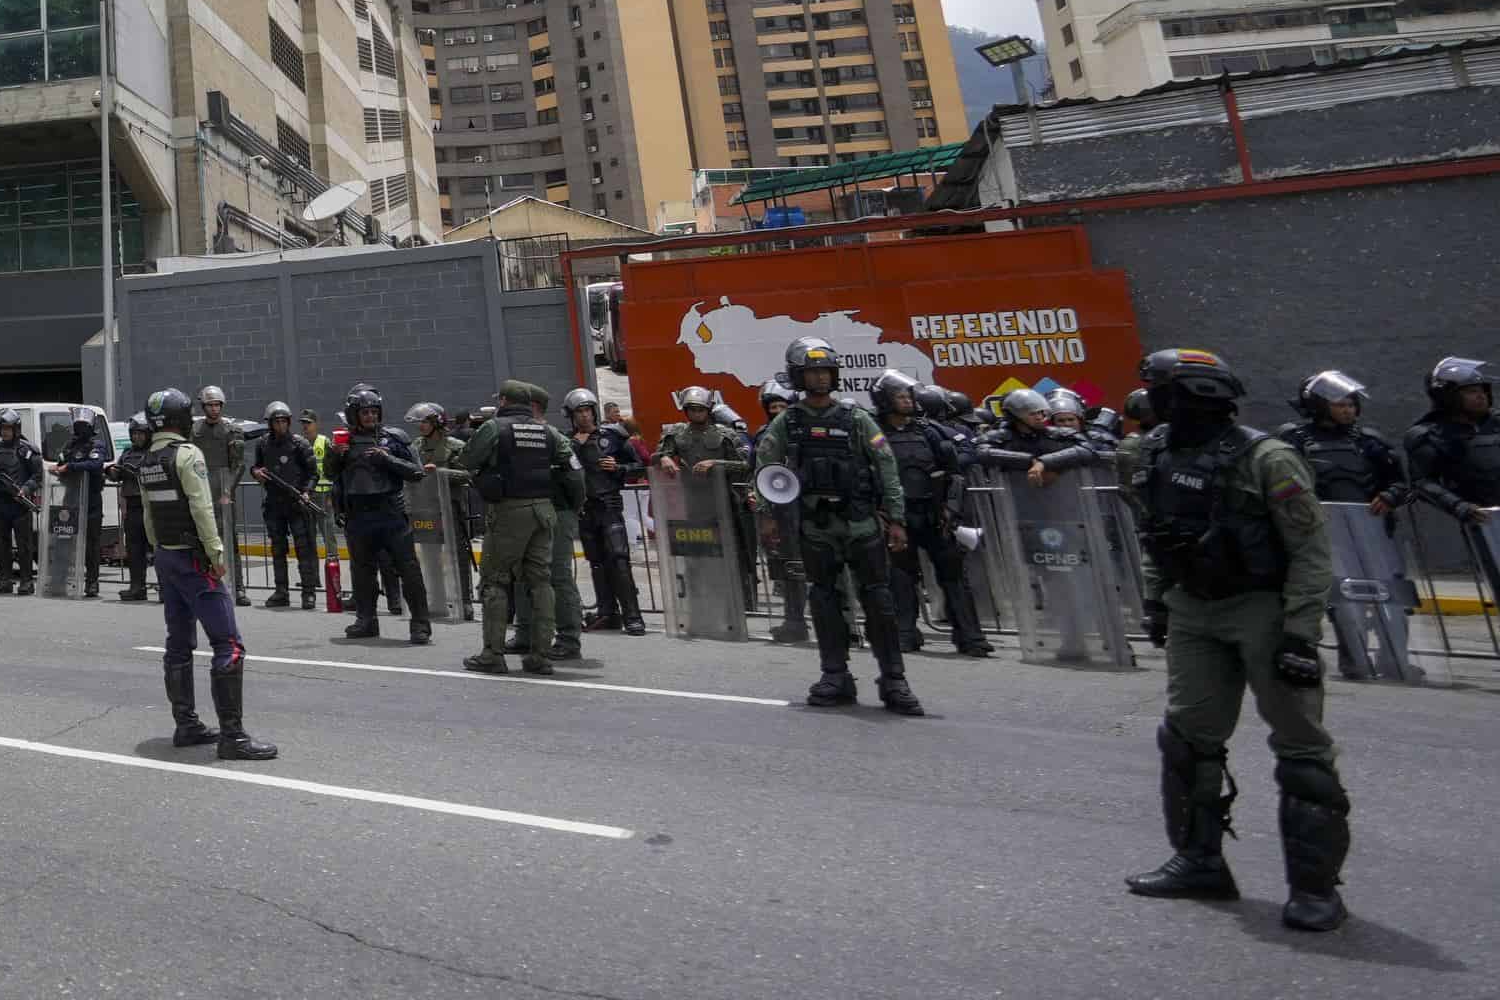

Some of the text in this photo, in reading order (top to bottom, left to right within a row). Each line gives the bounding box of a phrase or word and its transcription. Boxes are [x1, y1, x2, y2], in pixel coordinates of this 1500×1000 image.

[911, 308, 1078, 340] REFERENDO
[837, 353, 887, 369] EQUIBO
[933, 337, 1086, 368] CONSULTIVO
[1033, 552, 1080, 566] CPNB
